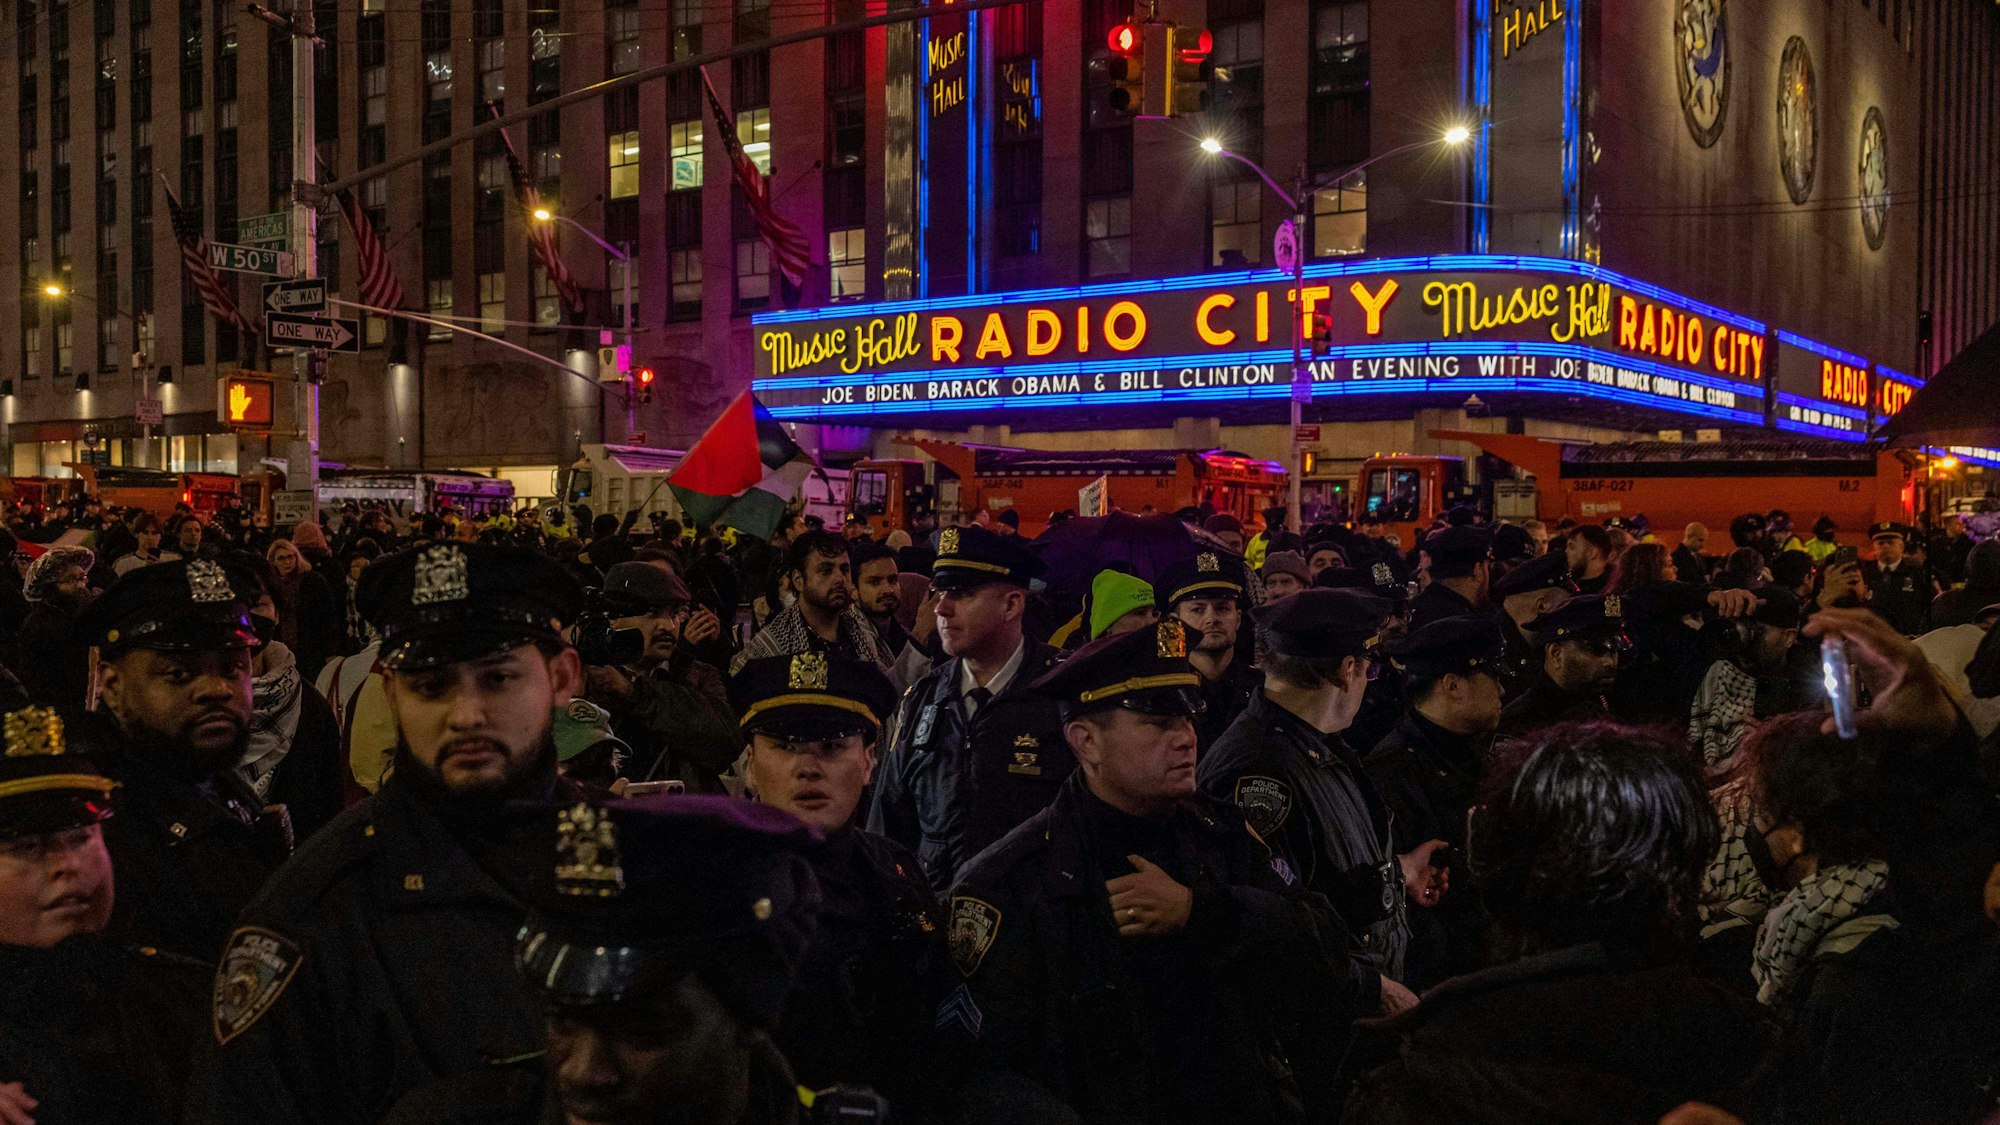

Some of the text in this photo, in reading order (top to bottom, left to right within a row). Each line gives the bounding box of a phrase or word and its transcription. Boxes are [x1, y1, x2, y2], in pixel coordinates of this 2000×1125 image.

[1503, 0, 1563, 58] HALL
[928, 31, 965, 77] MUSIC
[933, 76, 965, 117] HALL
[240, 222, 284, 241] AMERICAS
[212, 246, 275, 270] W 50 ST
[274, 289, 319, 305] ONE WAY
[1423, 281, 1611, 342] Music Hall
[277, 323, 341, 341] ONE WAY
[931, 279, 1399, 363] RADIO CITY
[1620, 295, 1764, 379] RADIO CITY
[761, 312, 921, 375] Music Hall
[822, 386, 854, 404] JOE
[927, 379, 999, 399] BARACK
[1012, 375, 1081, 396] OBAMA
[1094, 373, 1105, 392] &
[1120, 370, 1164, 390] BILL
[1179, 364, 1274, 388] CLINTON
[1308, 361, 1335, 381] AN
[1352, 356, 1460, 380] EVENING
[1478, 355, 1535, 376] WITH
[1550, 358, 1581, 378] JOE
[1822, 360, 1868, 407] RADIO
[1883, 379, 1912, 415] CITY
[1573, 480, 1634, 491] 38AF-027
[1240, 786, 1287, 803] DEPARTMENT
[1251, 780, 1280, 792] POLICE
[963, 901, 986, 915] POLICE
